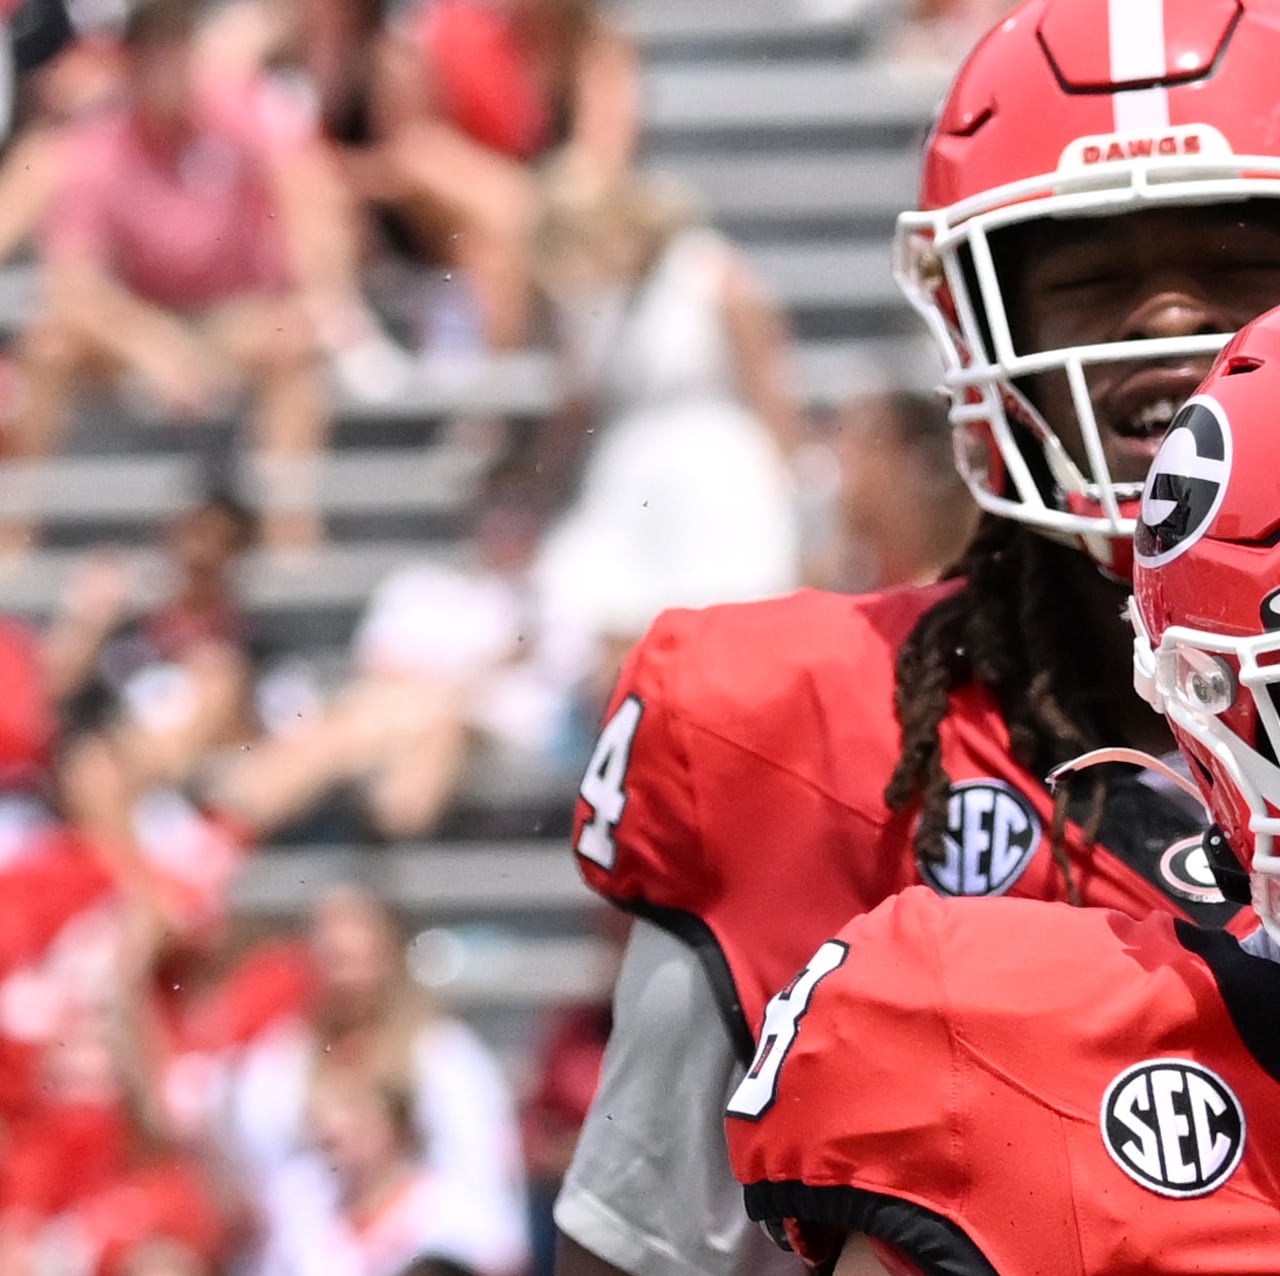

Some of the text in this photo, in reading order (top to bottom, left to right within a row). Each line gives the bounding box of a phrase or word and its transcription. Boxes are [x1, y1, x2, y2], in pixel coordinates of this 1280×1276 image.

[1082, 134, 1201, 165] DAWGS
[576, 694, 642, 870] 4
[725, 938, 849, 1121] 8
[1112, 1069, 1229, 1184] SEC
